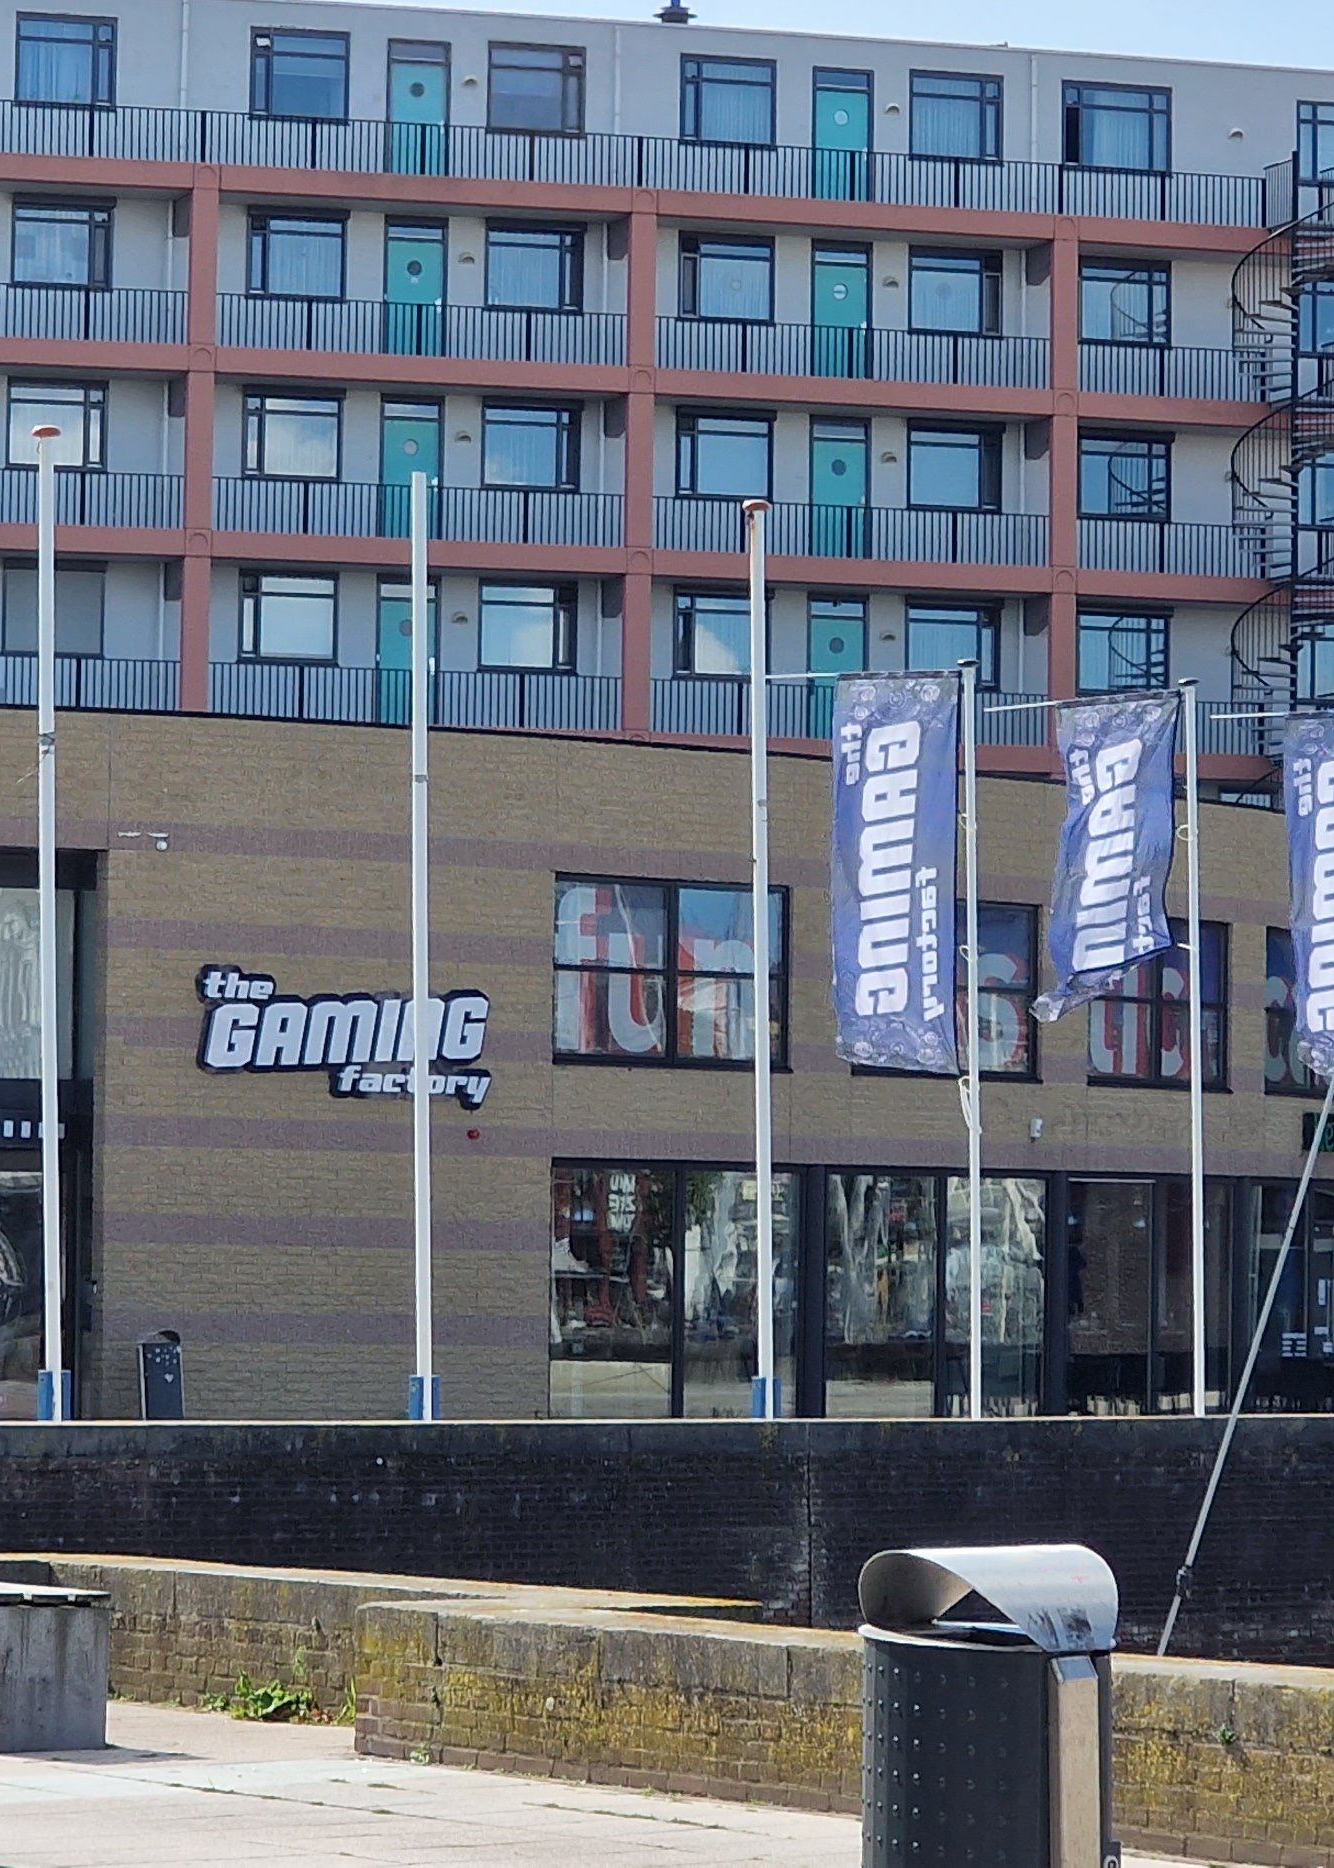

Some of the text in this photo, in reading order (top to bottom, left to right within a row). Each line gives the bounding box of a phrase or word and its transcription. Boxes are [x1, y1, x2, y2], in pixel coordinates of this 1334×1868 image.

[203, 971, 275, 1000] the
[203, 996, 490, 1068] GAMING
[337, 1065, 492, 1104] factory
